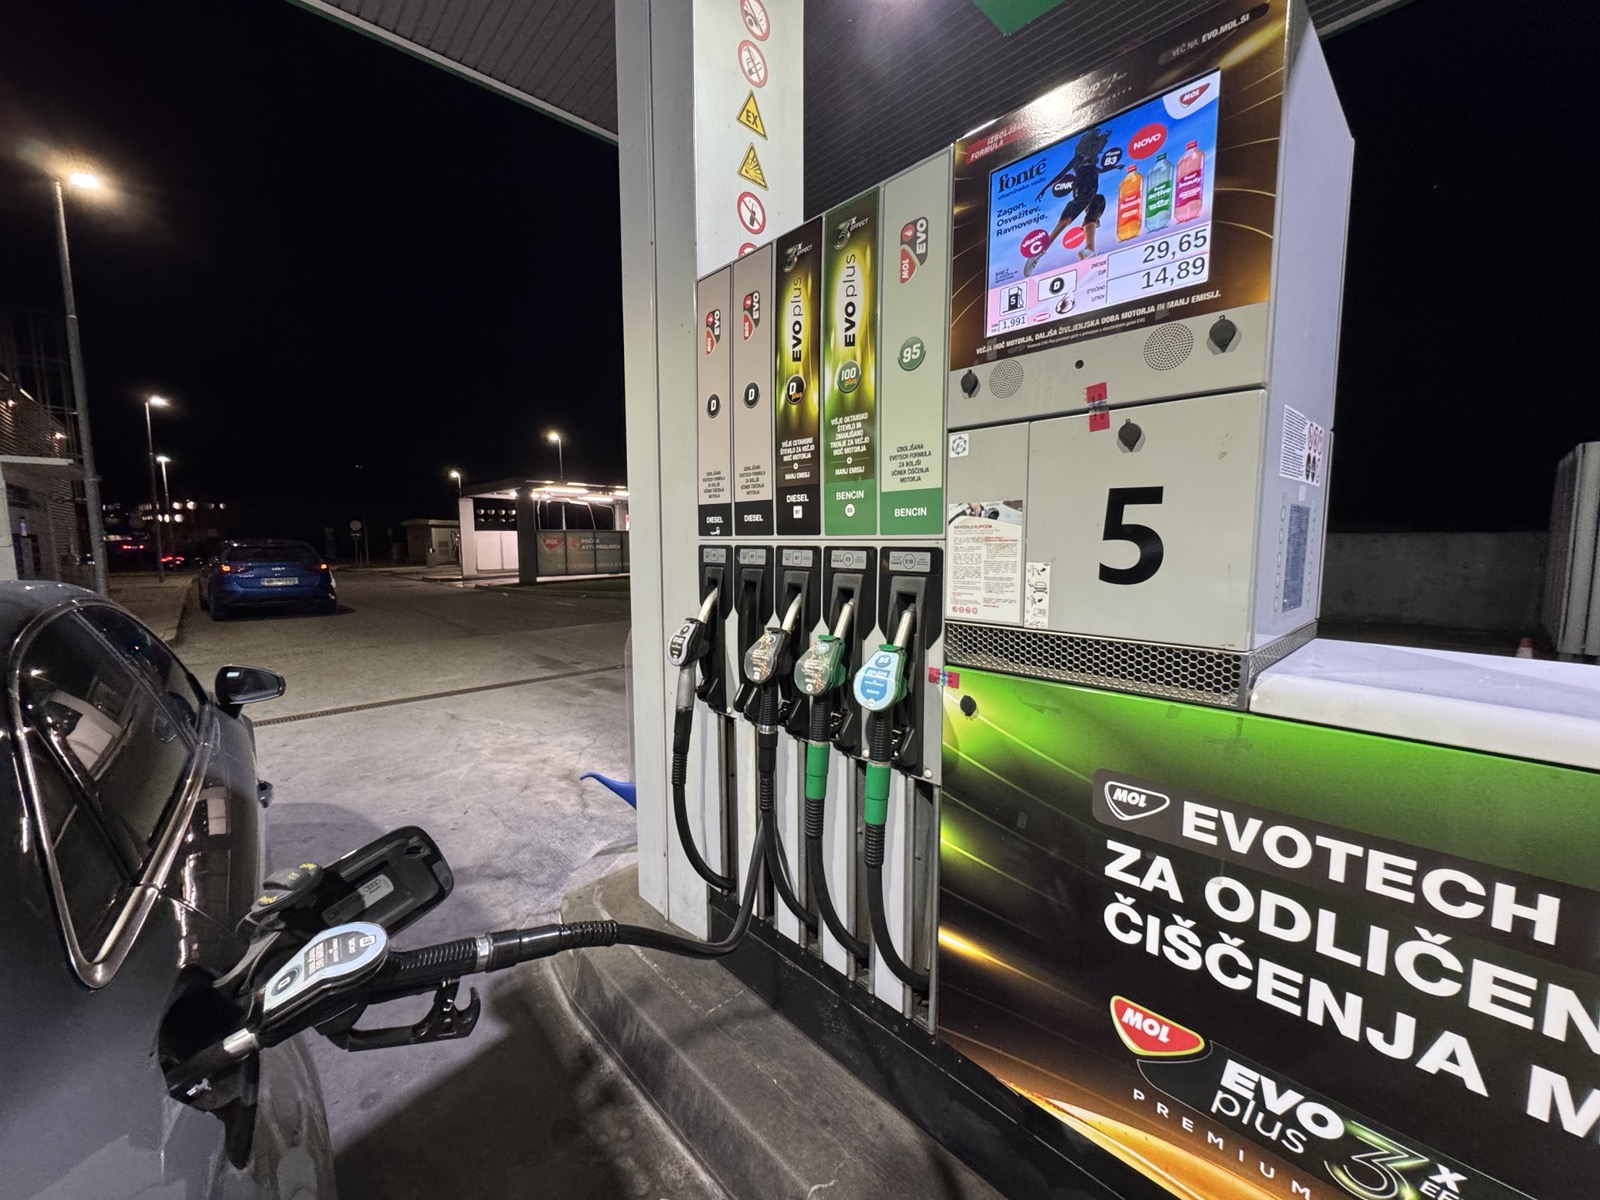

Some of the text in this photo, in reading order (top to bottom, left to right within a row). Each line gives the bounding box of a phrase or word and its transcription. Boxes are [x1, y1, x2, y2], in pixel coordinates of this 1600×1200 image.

[1172, 43, 1186, 57] VEČ
[1202, 13, 1250, 43] EVO.MOL.SI
[1183, 90, 1200, 102] MOL
[746, 110, 759, 128] EX
[1133, 133, 1162, 150] NOVO
[970, 139, 1004, 162] FORMULA
[1104, 156, 1117, 166] B3
[1054, 182, 1073, 191] CINK
[1179, 176, 1201, 188] beauty
[1148, 188, 1170, 200] active
[997, 202, 1027, 218] Zagon.
[997, 206, 1041, 227] Osvežitev.
[850, 218, 869, 232] EFFECT
[997, 214, 1048, 237] Ravnovesje.
[916, 218, 927, 254] EVO
[1022, 232, 1046, 248] vitamin
[797, 244, 813, 256] EFFECT
[1030, 241, 1042, 254] C
[1142, 228, 1207, 264] 29,65
[1141, 256, 1205, 289] 14,89
[1054, 282, 1060, 290] D
[843, 254, 857, 347] EVO plus
[1010, 296, 1016, 305] 5
[790, 277, 803, 362] EVO plus
[1002, 316, 1026, 329] 1,991
[1006, 336, 1033, 347] MOTORJA,
[1035, 329, 1057, 340] DALJŠA
[1058, 318, 1100, 336] ŽIVLJENJSKA
[1101, 314, 1119, 325] DOBA
[1121, 306, 1155, 320] MOTORJA
[1167, 296, 1189, 309] MANJ
[1191, 290, 1221, 303] EMISIJ.
[902, 344, 921, 363] 95
[841, 367, 856, 381] 100
[748, 389, 755, 400] D
[789, 382, 796, 395] D
[711, 400, 716, 411] D
[831, 412, 868, 426] VIŠJE OKTANSKO
[837, 423, 855, 432] ŠTEVILO
[854, 436, 869, 445] VEČJO
[844, 445, 866, 454] MOTORJA
[910, 450, 931, 458] FORMULA
[786, 494, 809, 502] DIESEL
[836, 490, 864, 500] BENCIN
[744, 514, 764, 522] DIESEL
[894, 507, 927, 517] BENCIN
[1098, 486, 1164, 586] 5
[1113, 788, 1147, 808] MOL
[1182, 801, 1561, 946] EVOTECH
[1104, 839, 1600, 1057] ZA ODLIČEN
[1103, 891, 1489, 1098] ČIŠČENJA
[1121, 1008, 1172, 1044] MOL
[1220, 1059, 1344, 1140] EVO
[1210, 1090, 1307, 1154] plus
[1132, 1088, 1311, 1200] PREMIUM
[1324, 1120, 1430, 1200] 3
[1428, 1162, 1467, 1192] X
